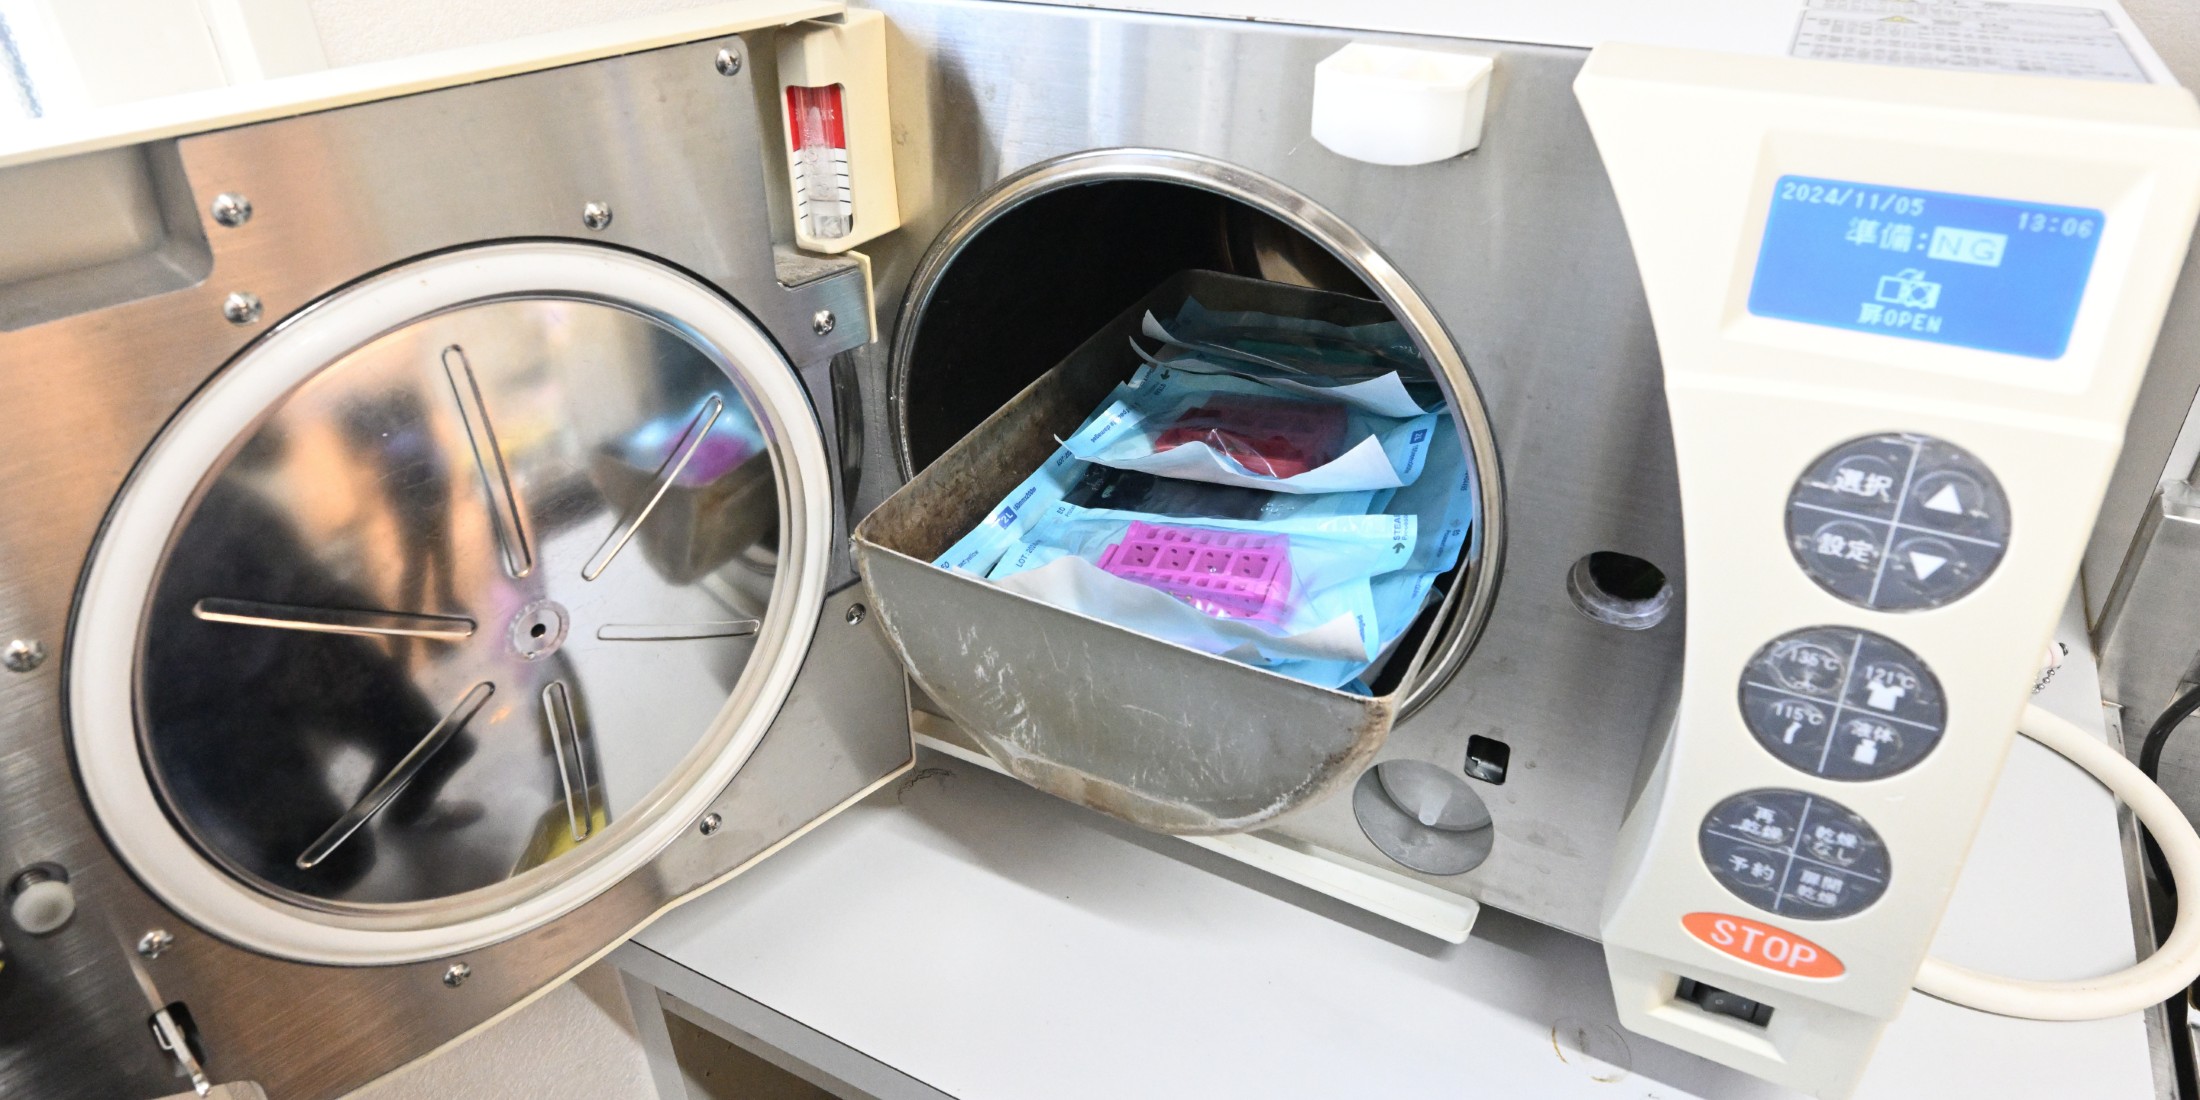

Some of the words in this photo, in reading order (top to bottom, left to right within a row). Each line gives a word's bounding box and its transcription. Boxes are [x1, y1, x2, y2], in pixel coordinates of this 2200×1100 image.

[1781, 181, 1926, 217] 2024/11/05
[2018, 211, 2093, 239] 13:06
[1835, 468, 1893, 502] 選択
[1001, 511, 1015, 525] 2L
[1817, 532, 1876, 563] 設定
[1865, 665, 1916, 690] 121°C
[1774, 703, 1824, 726] 115°C
[1850, 719, 1894, 744] 液体
[1738, 818, 1783, 841] 乾燥
[1815, 825, 1858, 849] 乾燥
[1728, 854, 1776, 881] 予約
[1797, 883, 1838, 906] 乾燥
[1709, 919, 1818, 969] STOP
